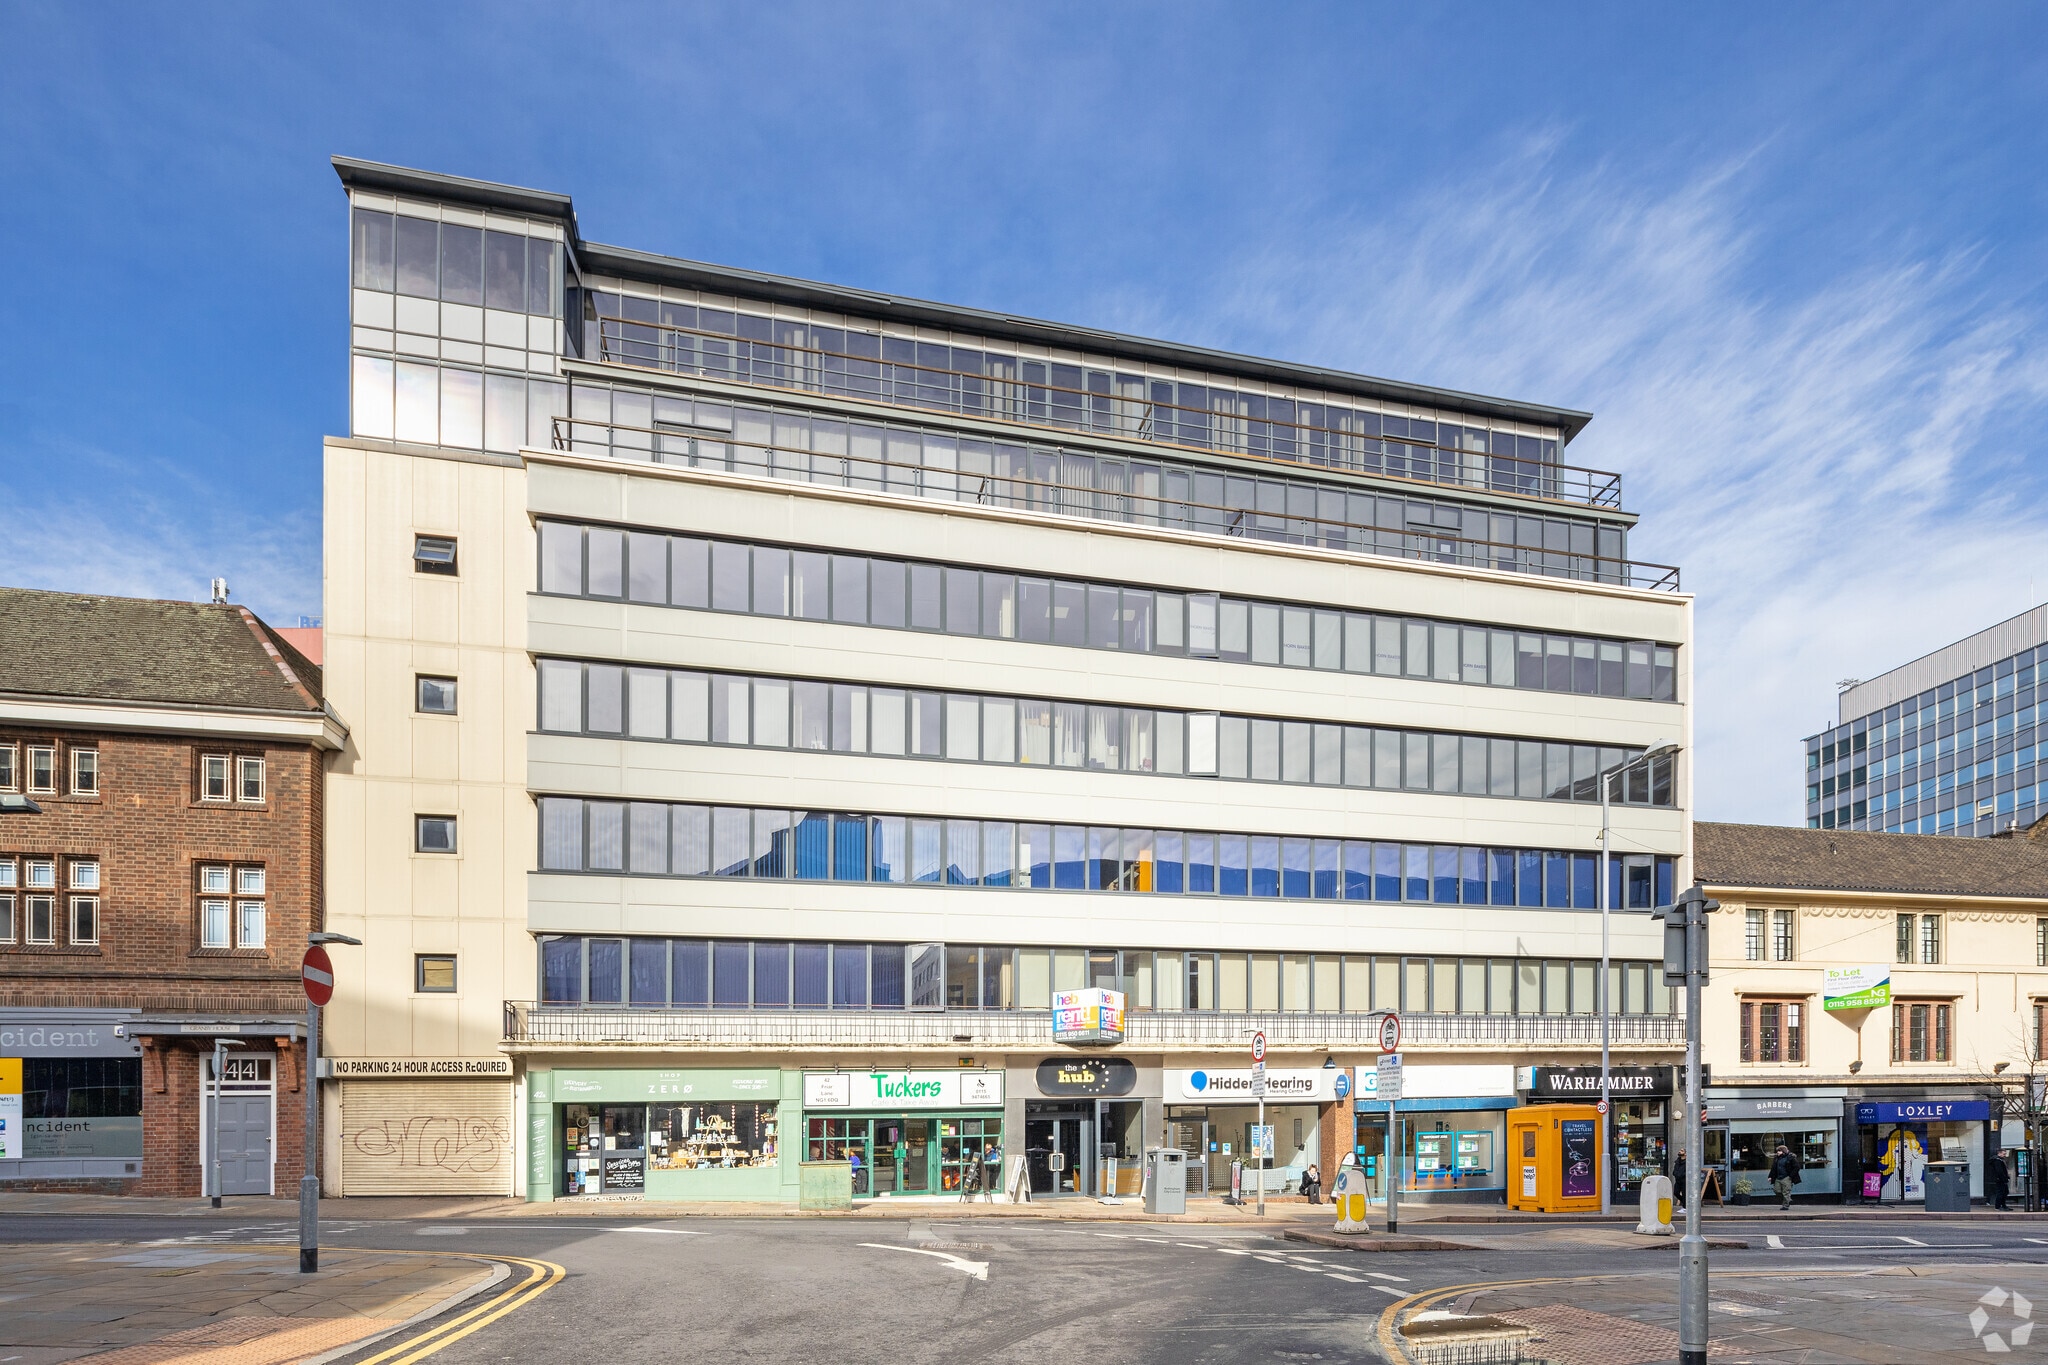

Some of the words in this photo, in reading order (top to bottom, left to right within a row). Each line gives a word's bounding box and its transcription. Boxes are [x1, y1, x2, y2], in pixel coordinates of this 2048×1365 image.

[1828, 970, 1840, 978] To
[1843, 968, 1861, 977] Let
[1871, 988, 1886, 998] NG
[1056, 993, 1079, 1006] heb
[1846, 999, 1863, 1007] 958
[1863, 997, 1886, 1005] 8599
[336, 1061, 349, 1073] NO
[351, 1061, 389, 1073] PARKING
[391, 1061, 402, 1073] 24
[404, 1061, 428, 1073] HOUR
[430, 1061, 463, 1073] ACCESS
[1057, 1070, 1095, 1083] hub
[1549, 1074, 1654, 1090] WARHAMMER
[869, 1074, 941, 1099] Tuckers
[1756, 1101, 1792, 1110] BARBERS
[1897, 1105, 1953, 1117] LOXLEY
[22, 1121, 91, 1132] ncident
